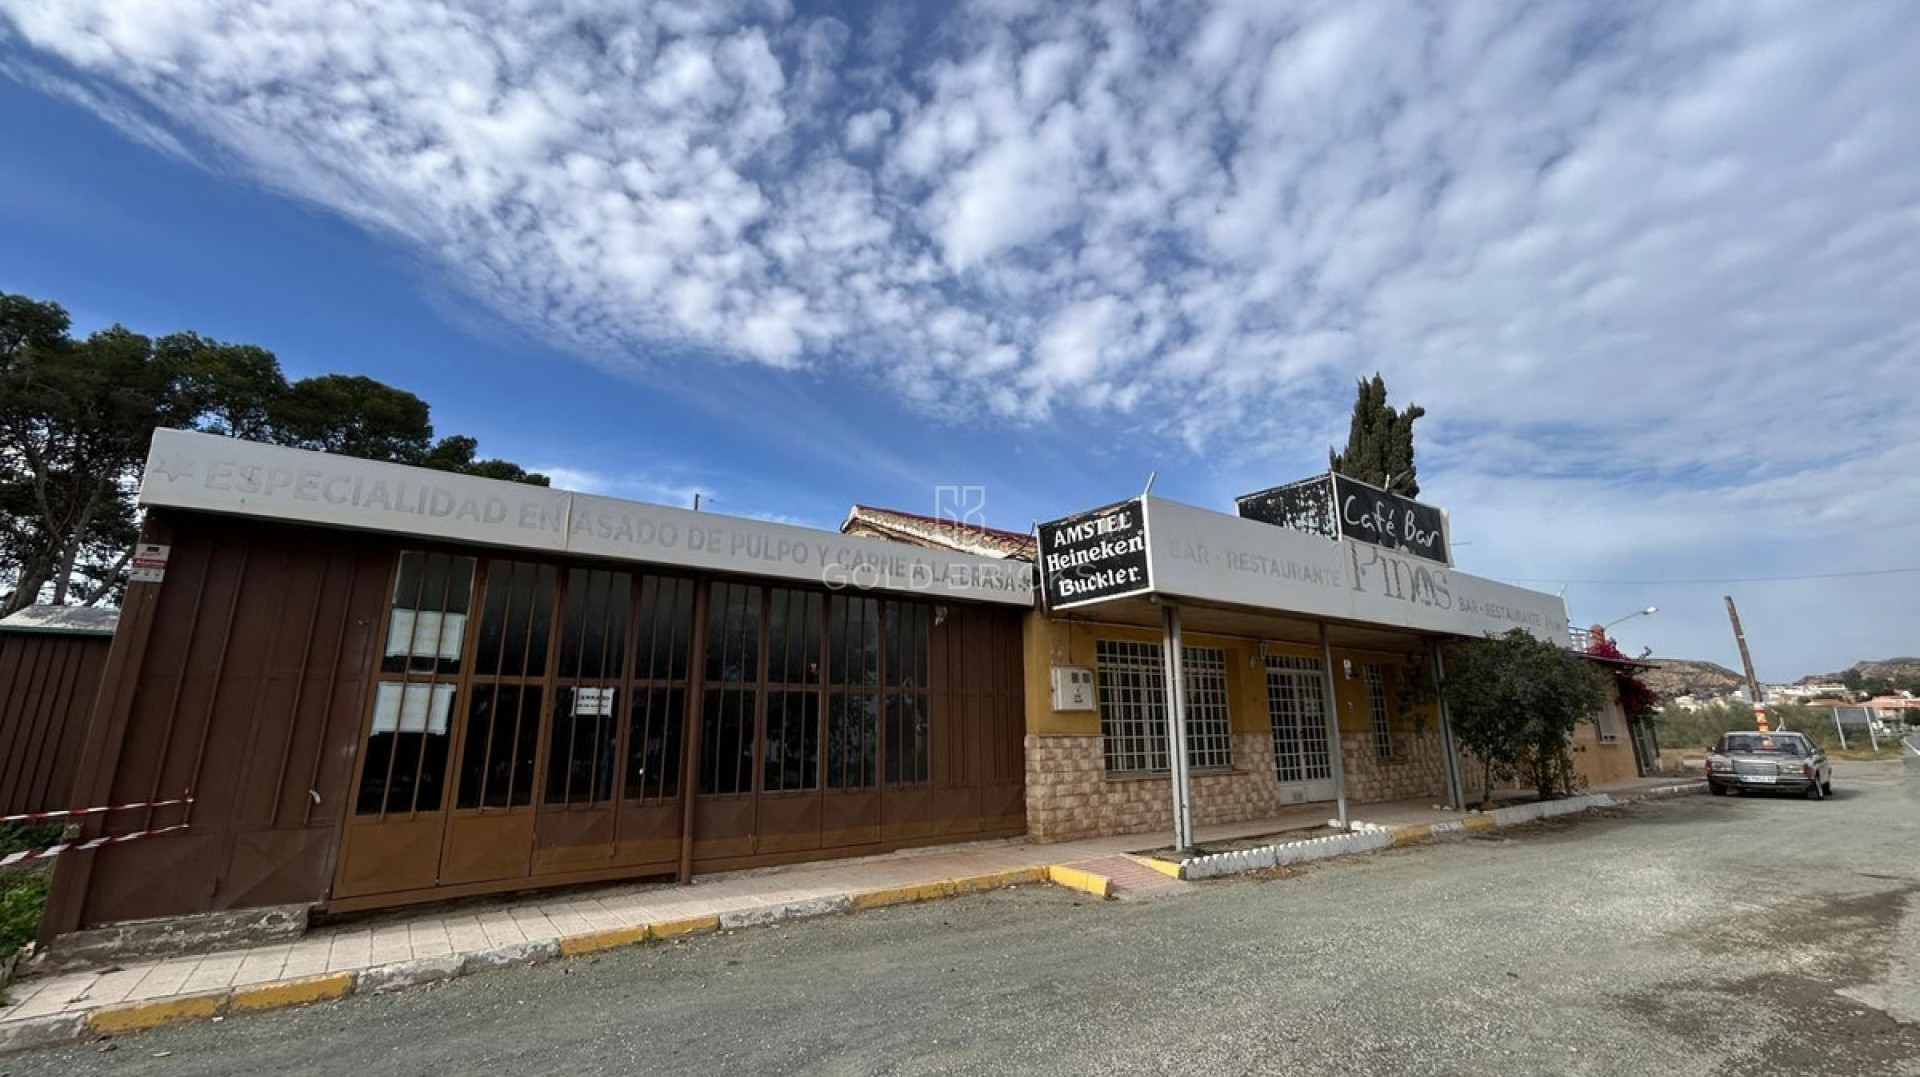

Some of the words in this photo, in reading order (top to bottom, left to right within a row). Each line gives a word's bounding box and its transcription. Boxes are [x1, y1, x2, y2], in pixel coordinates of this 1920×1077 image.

[204, 460, 507, 524] ESPECIALIDAD
[518, 503, 560, 532] EN
[572, 510, 678, 549] ASADO
[688, 523, 722, 554] DE
[730, 535, 810, 565] PULPO
[816, 543, 829, 567] Y
[836, 550, 905, 578] CARNE
[912, 558, 925, 580] A
[959, 567, 1017, 592] BRASA
[1053, 511, 1132, 548] AMSTEL
[1344, 493, 1398, 538] Café
[1405, 509, 1440, 548] Bar
[1046, 533, 1145, 573] Heineken
[1166, 535, 1210, 566] BAR
[1225, 547, 1341, 588] RESTAURANTE
